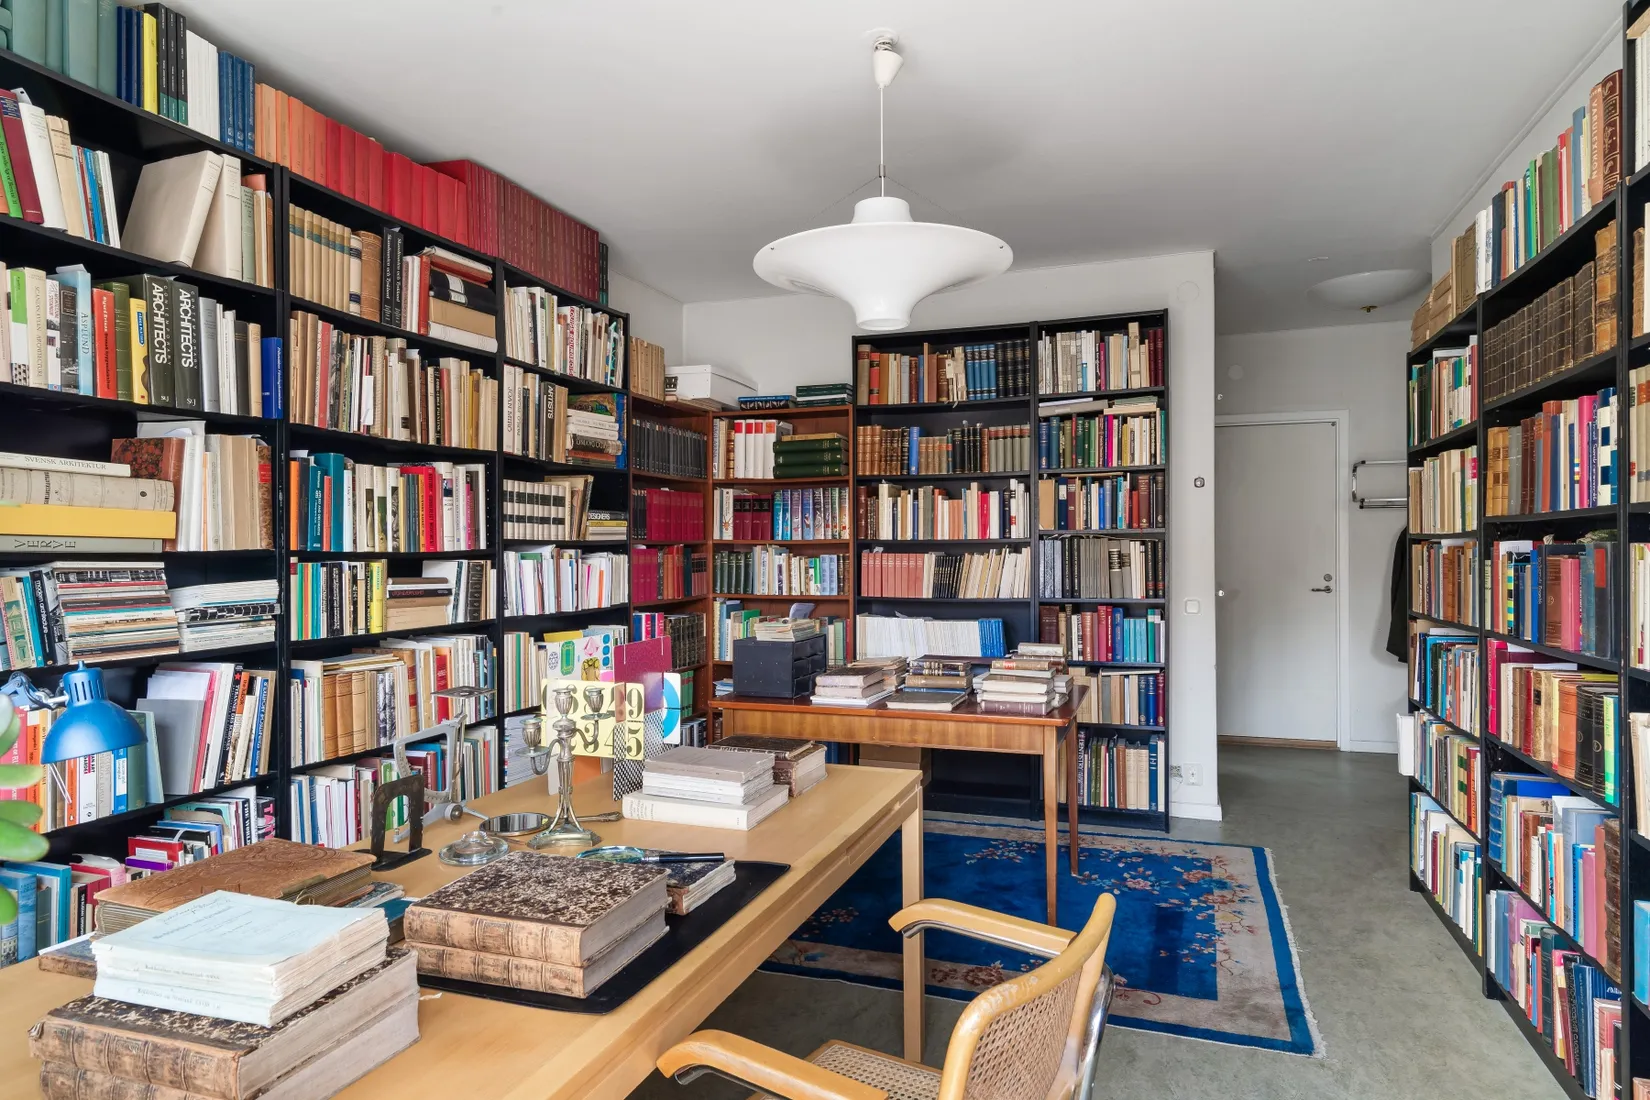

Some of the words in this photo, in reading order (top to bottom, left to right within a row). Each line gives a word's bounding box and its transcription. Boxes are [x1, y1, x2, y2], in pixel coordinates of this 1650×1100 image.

[34, 286, 42, 331] SCANDINAVIAN
[152, 283, 168, 364] ARCHITECTS
[163, 286, 171, 366] CONTEMPORARY
[80, 312, 90, 355] ASPLUND
[179, 289, 194, 368] ARCHITECTS
[190, 291, 198, 370] CONTEMPORARY
[35, 335, 43, 378] ARCHITECTURE
[25, 455, 57, 465] SVENSK
[58, 459, 106, 471] ARKITEKTUR
[588, 512, 611, 521] DESIGNERS
[14, 539, 76, 549] VERVE
[39, 603, 49, 634] architecture
[239, 688, 247, 705] lubok
[627, 688, 644, 720] 9
[626, 727, 643, 758] 5
